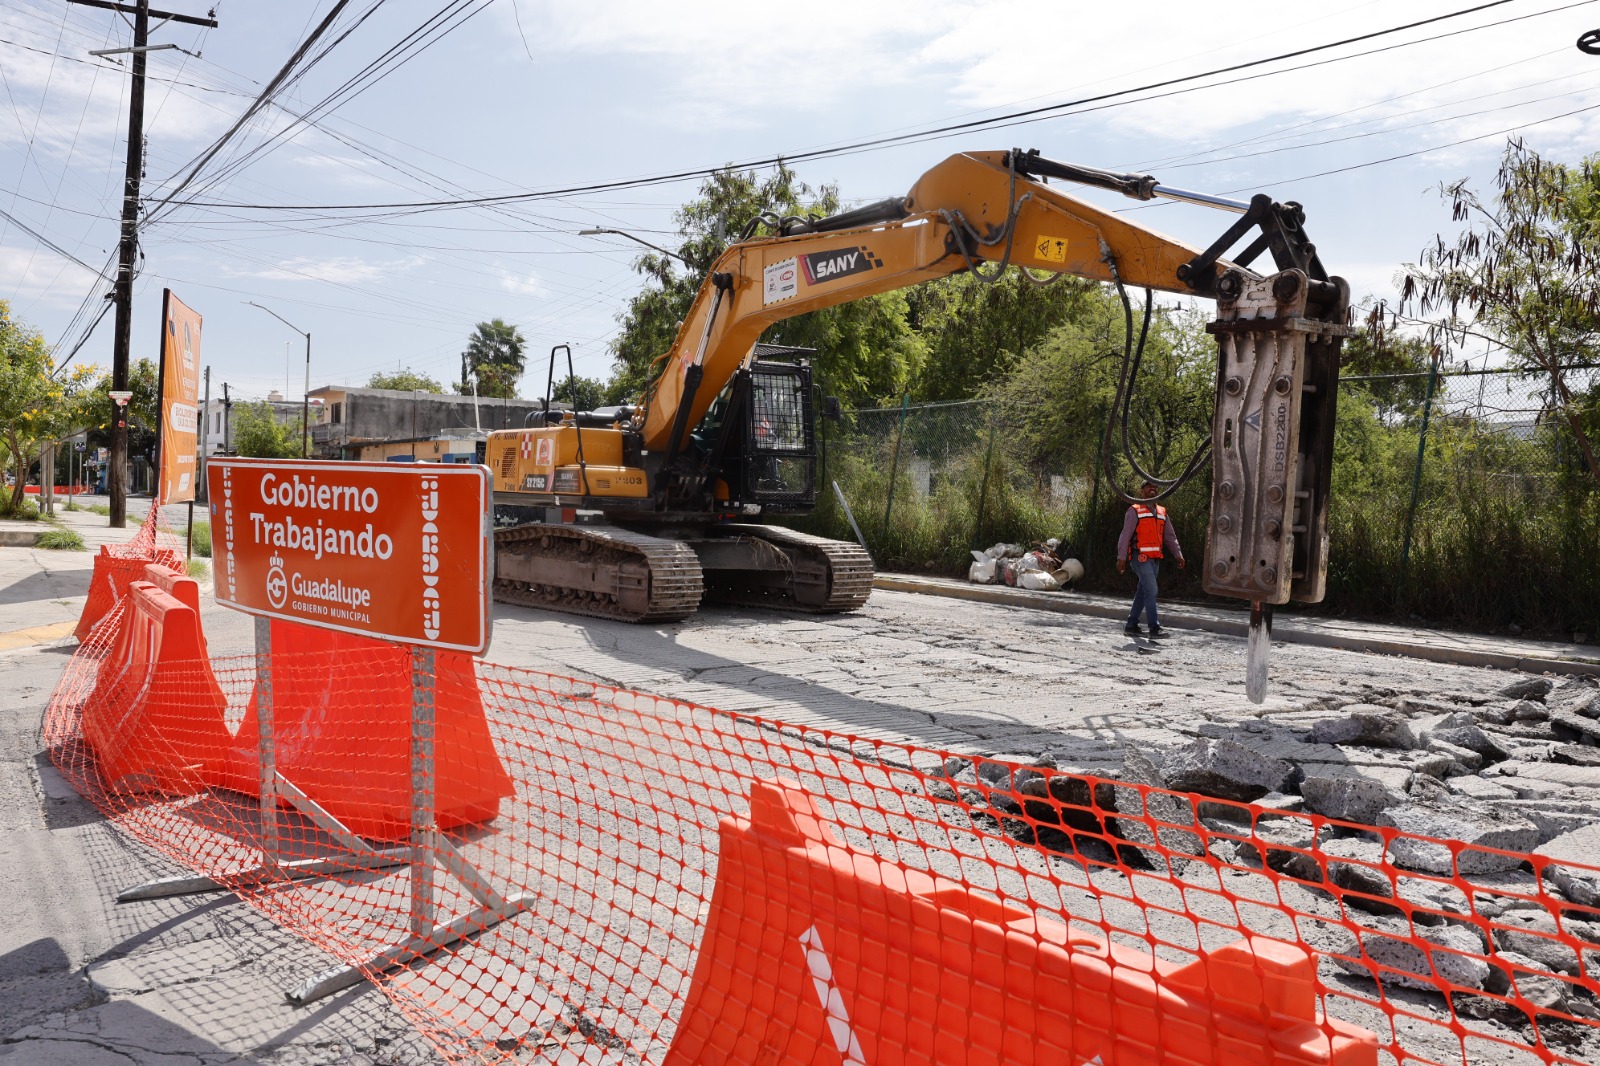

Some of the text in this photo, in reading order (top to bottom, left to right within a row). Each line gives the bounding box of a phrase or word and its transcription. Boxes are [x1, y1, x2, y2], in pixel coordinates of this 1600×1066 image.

[816, 251, 859, 279] SANY
[260, 472, 379, 514] Gobierno
[249, 512, 394, 560] Trabajando
[291, 572, 371, 609] Guadalupe
[292, 600, 371, 624] GOBIERNO MUNICIPAL
